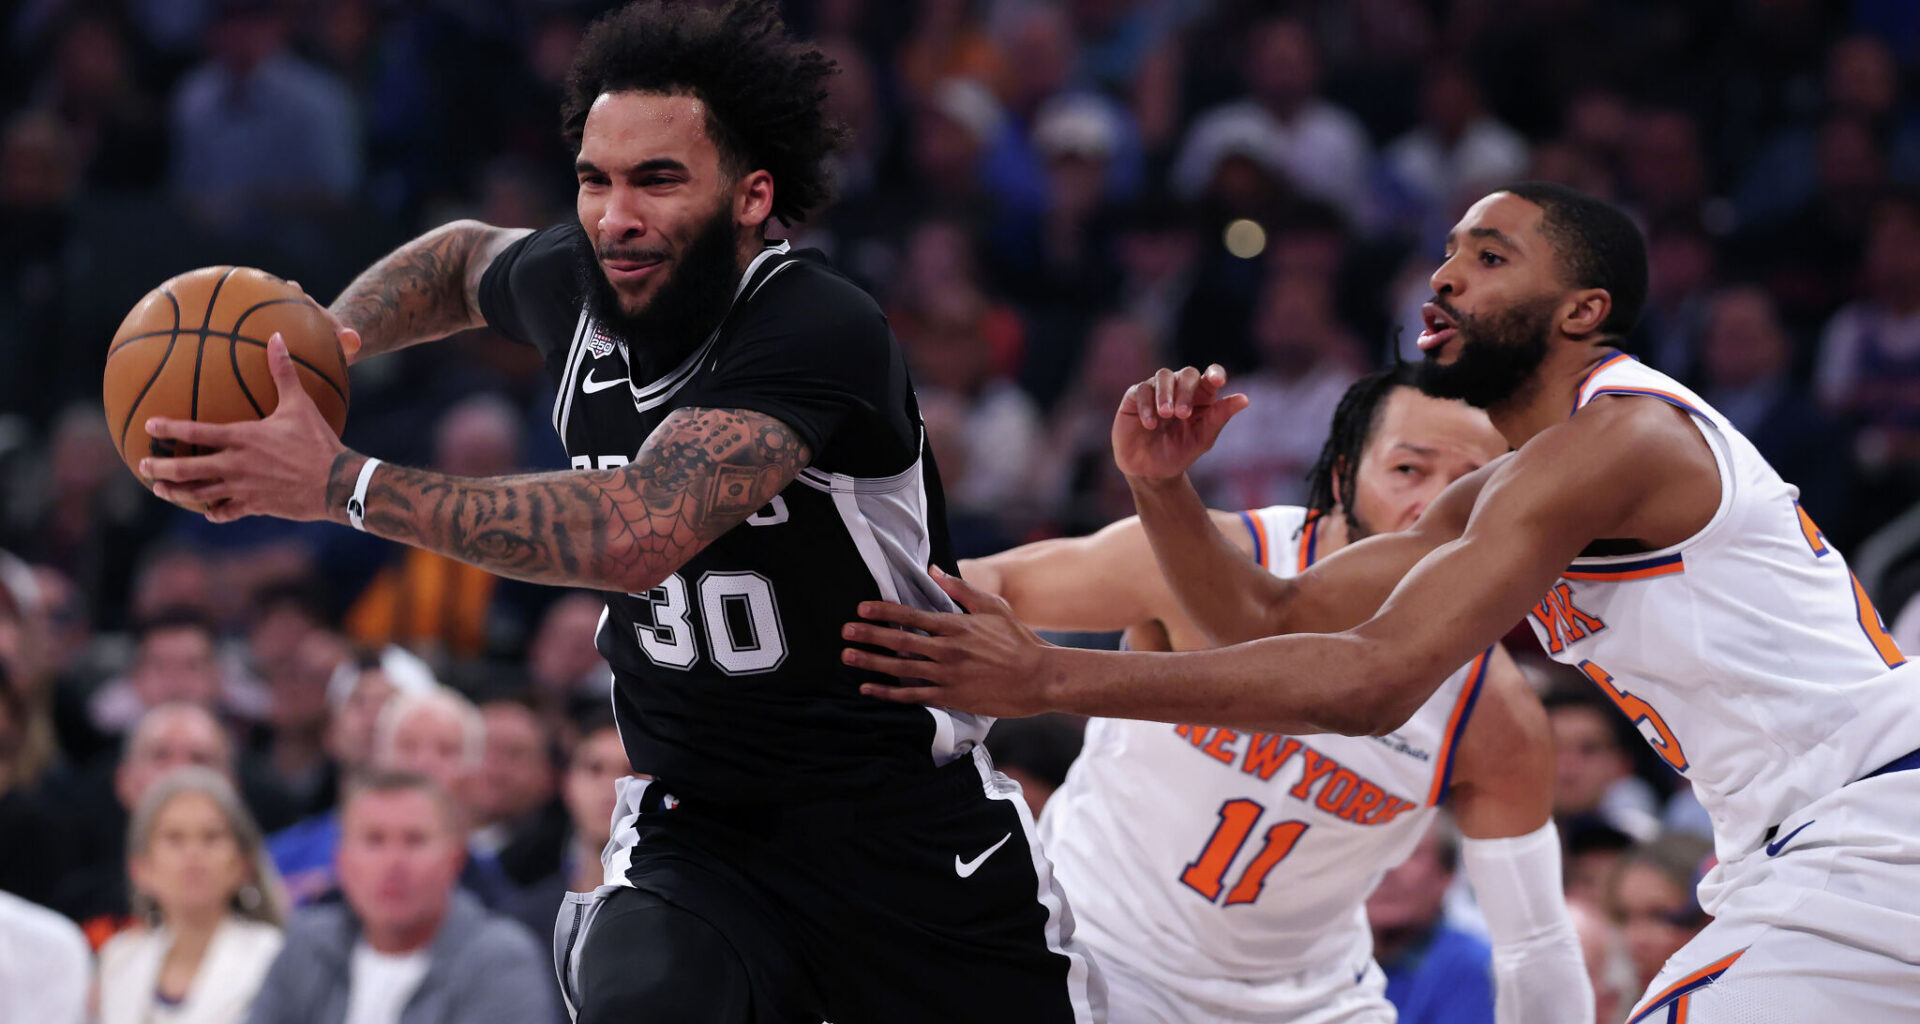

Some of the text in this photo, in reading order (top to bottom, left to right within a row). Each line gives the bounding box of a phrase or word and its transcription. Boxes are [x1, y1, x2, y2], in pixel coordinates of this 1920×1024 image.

[590, 338, 612, 352] 250
[628, 570, 789, 676] 30
[1289, 747, 1418, 826] YORK
[1179, 798, 1310, 908] 11
